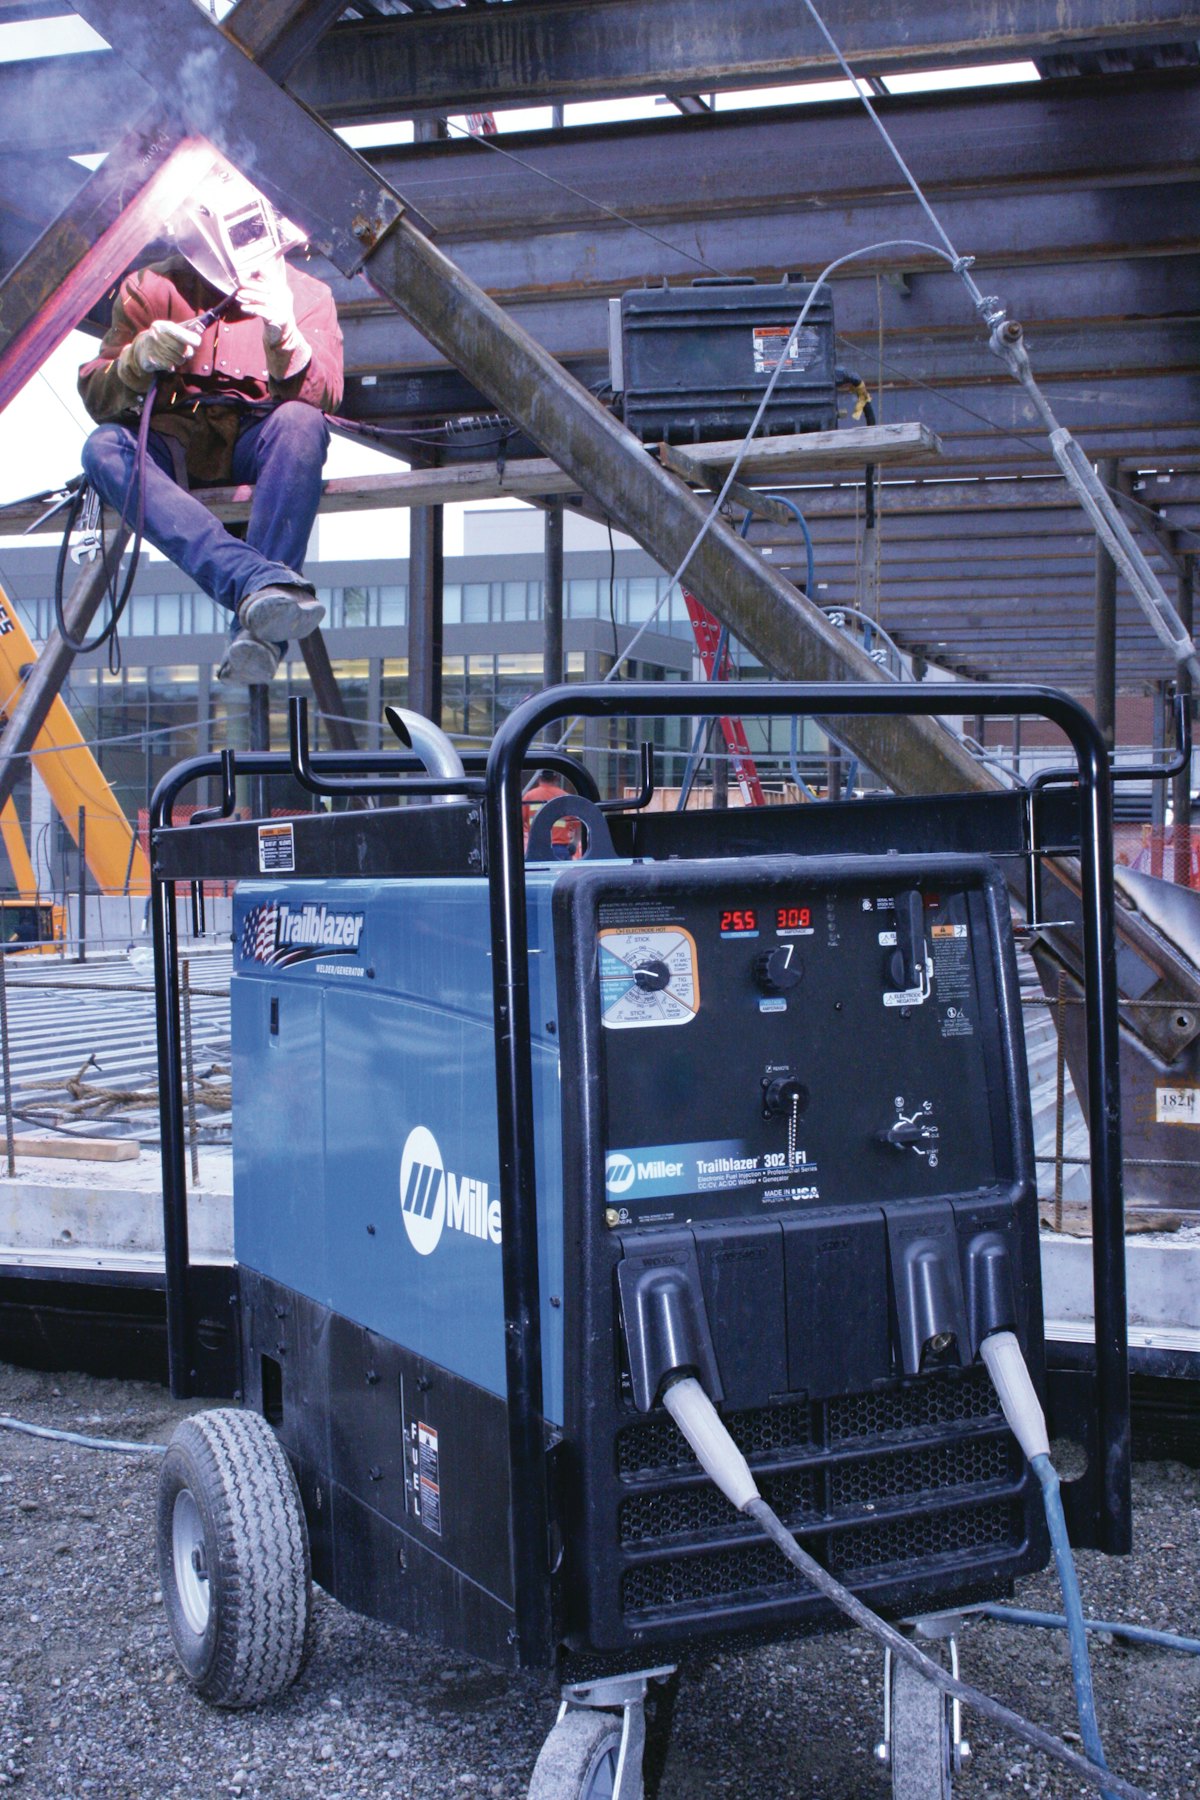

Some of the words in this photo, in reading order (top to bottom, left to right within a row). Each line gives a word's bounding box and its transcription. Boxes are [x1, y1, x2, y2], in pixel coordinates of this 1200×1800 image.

[278, 905, 364, 946] Trailblazer
[316, 964, 365, 977] WELDER/GENERATOR
[637, 1162, 683, 1181] Miller
[696, 1157, 758, 1174] Trailblazer
[764, 1153, 786, 1168] 302
[697, 1174, 725, 1182] Electronic
[738, 1171, 761, 1180] Injection
[762, 1175, 789, 1183] Generator
[764, 1189, 782, 1197] MADE
[791, 1187, 820, 1200] USA
[446, 1171, 503, 1245] Mille
[411, 1422, 420, 1516] FUEL
